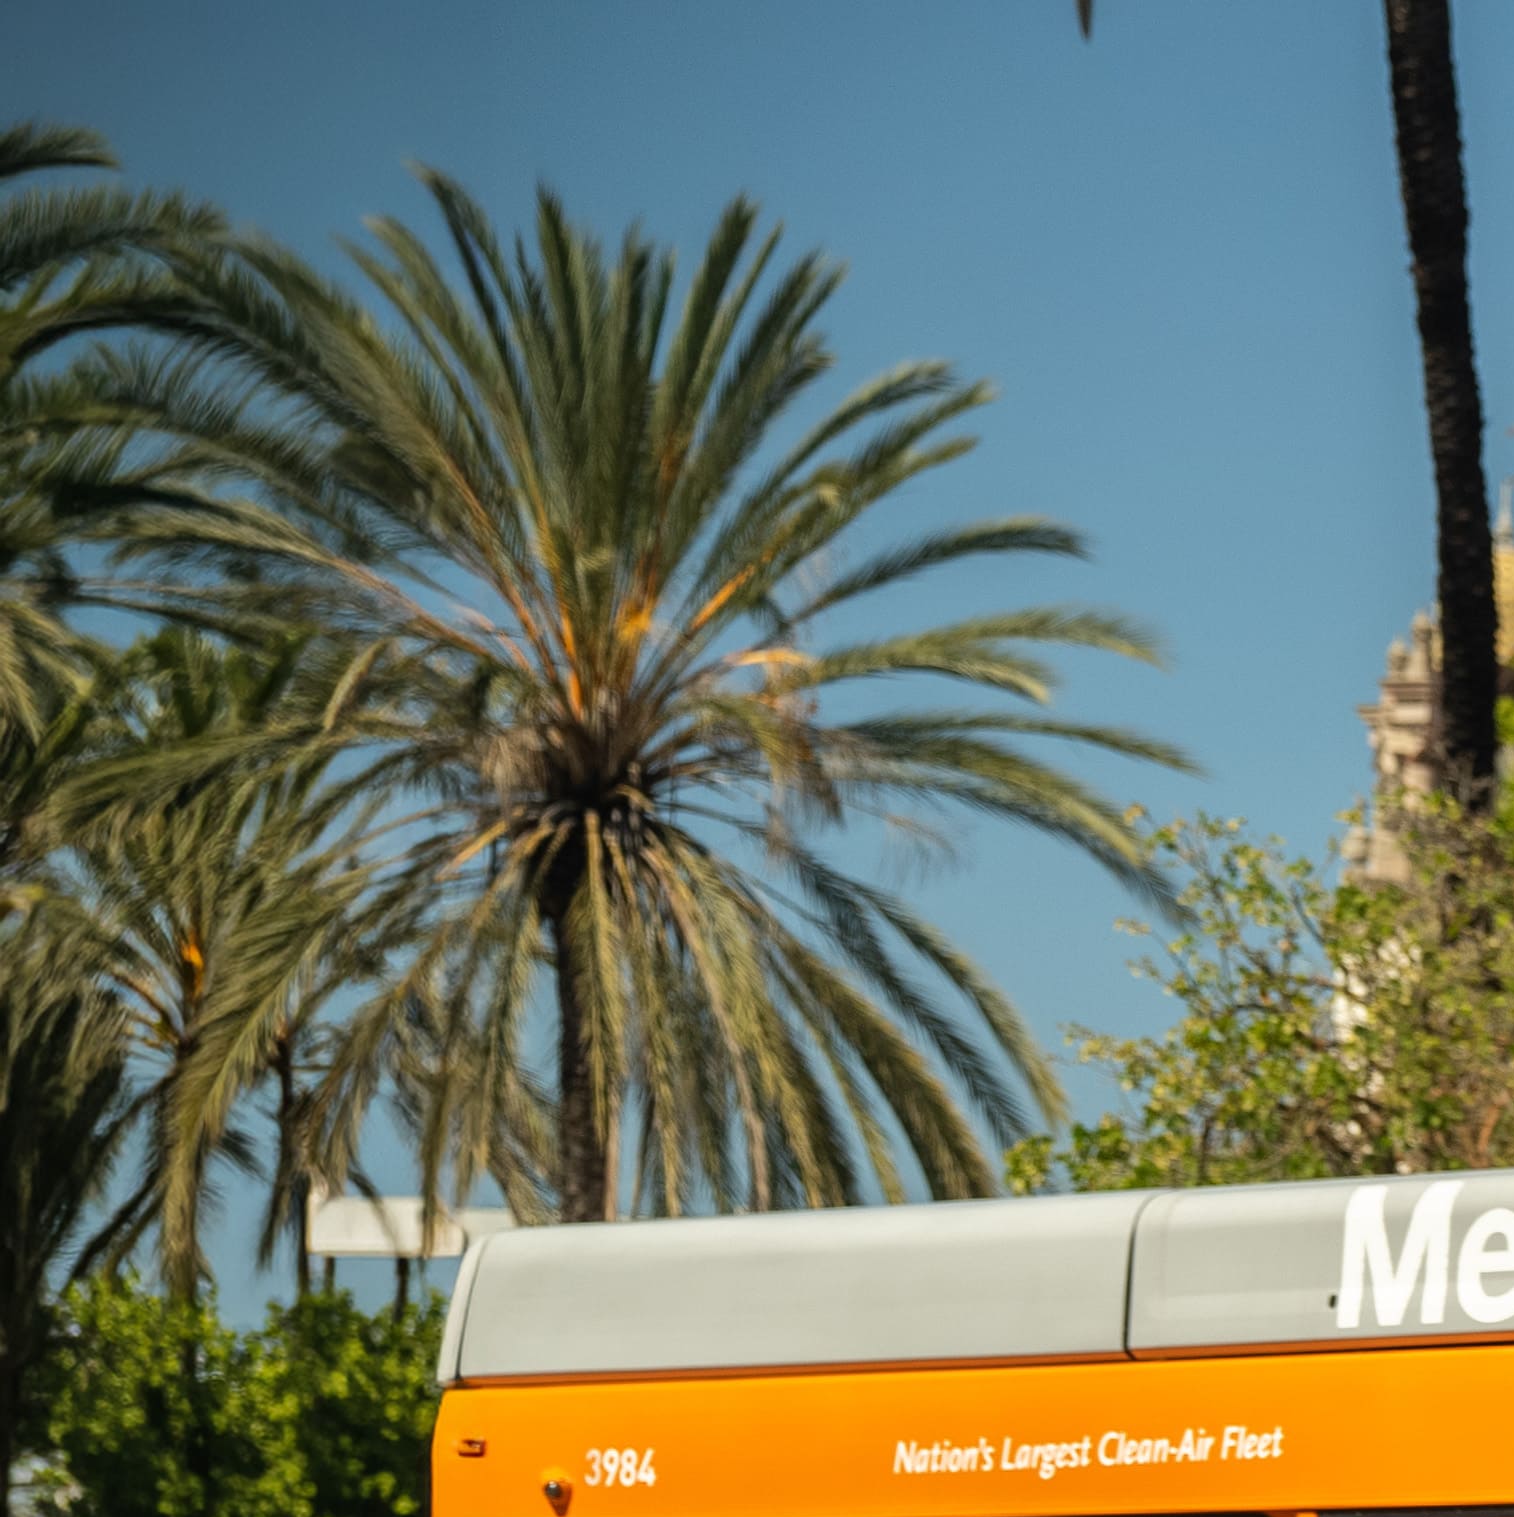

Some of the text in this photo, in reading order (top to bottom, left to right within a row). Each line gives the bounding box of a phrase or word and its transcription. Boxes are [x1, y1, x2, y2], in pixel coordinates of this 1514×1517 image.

[584, 1447, 657, 1487] 3984
[893, 1425, 1283, 1479] Nation's Largest Clean-Air Fleet
